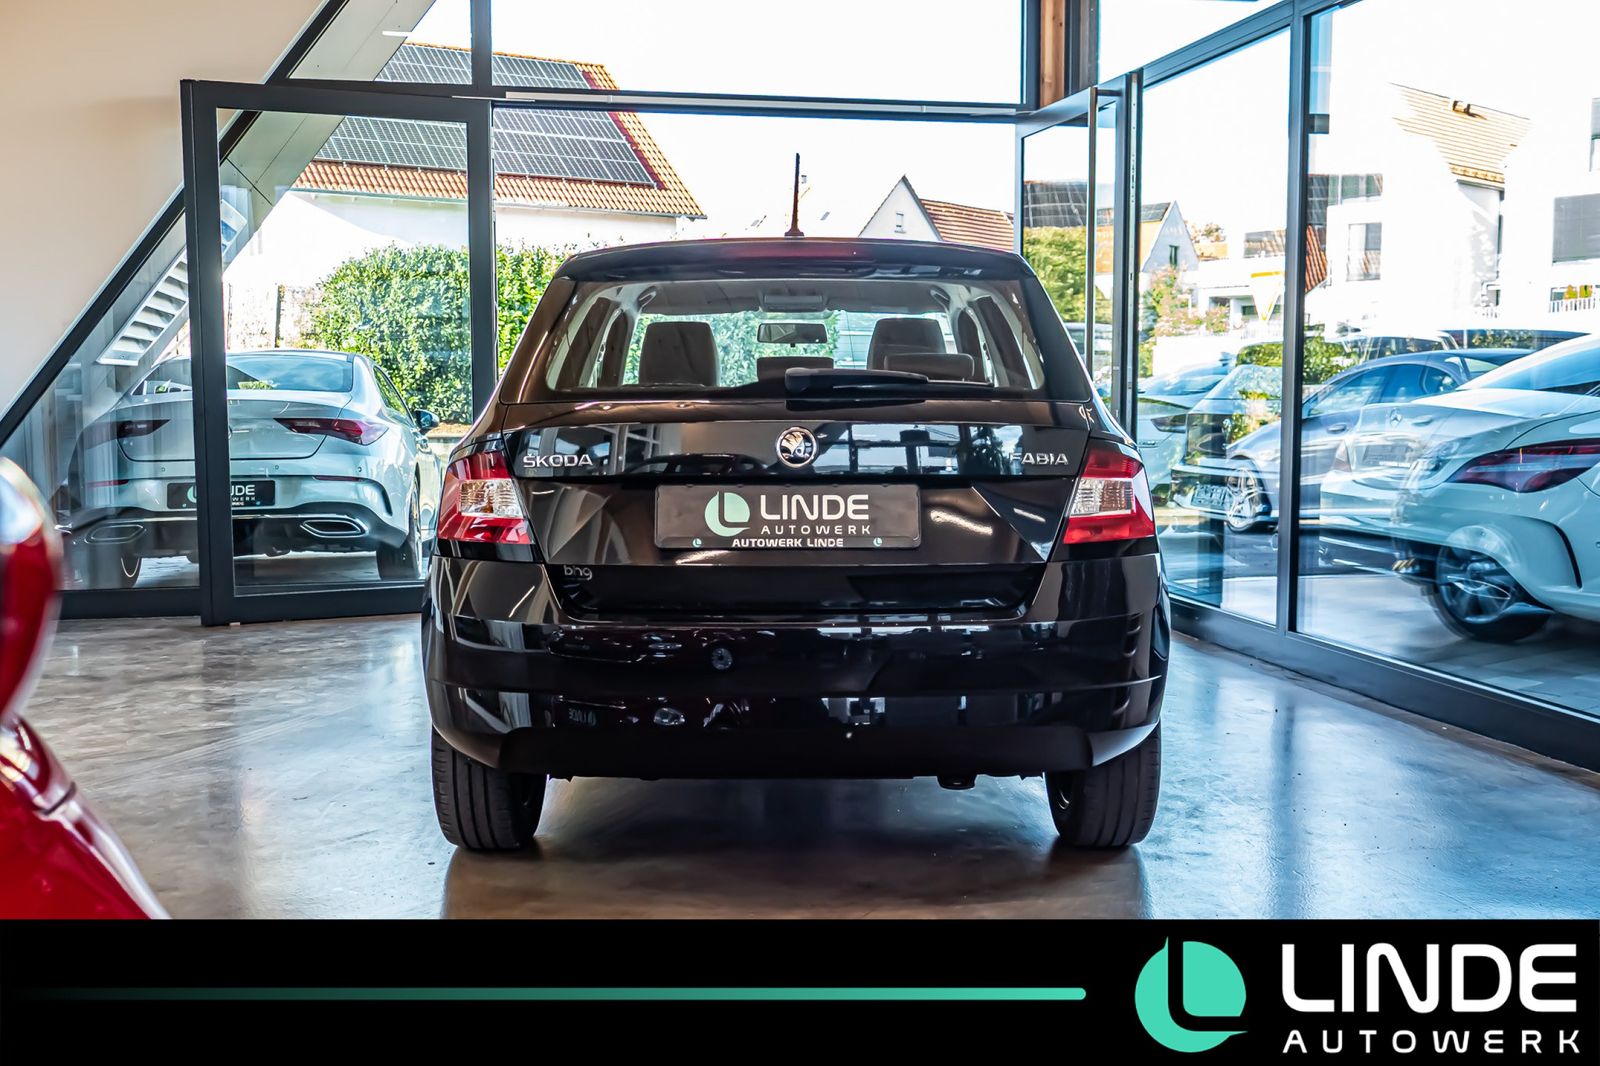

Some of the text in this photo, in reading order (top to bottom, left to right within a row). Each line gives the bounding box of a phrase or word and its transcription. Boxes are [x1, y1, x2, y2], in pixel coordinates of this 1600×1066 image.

[523, 453, 594, 468] ŠKODA
[1008, 452, 1069, 466] FABIA
[760, 494, 869, 521] LINDE
[760, 524, 871, 535] AUTOWERK
[731, 538, 844, 548] AUTOWERK LINDE
